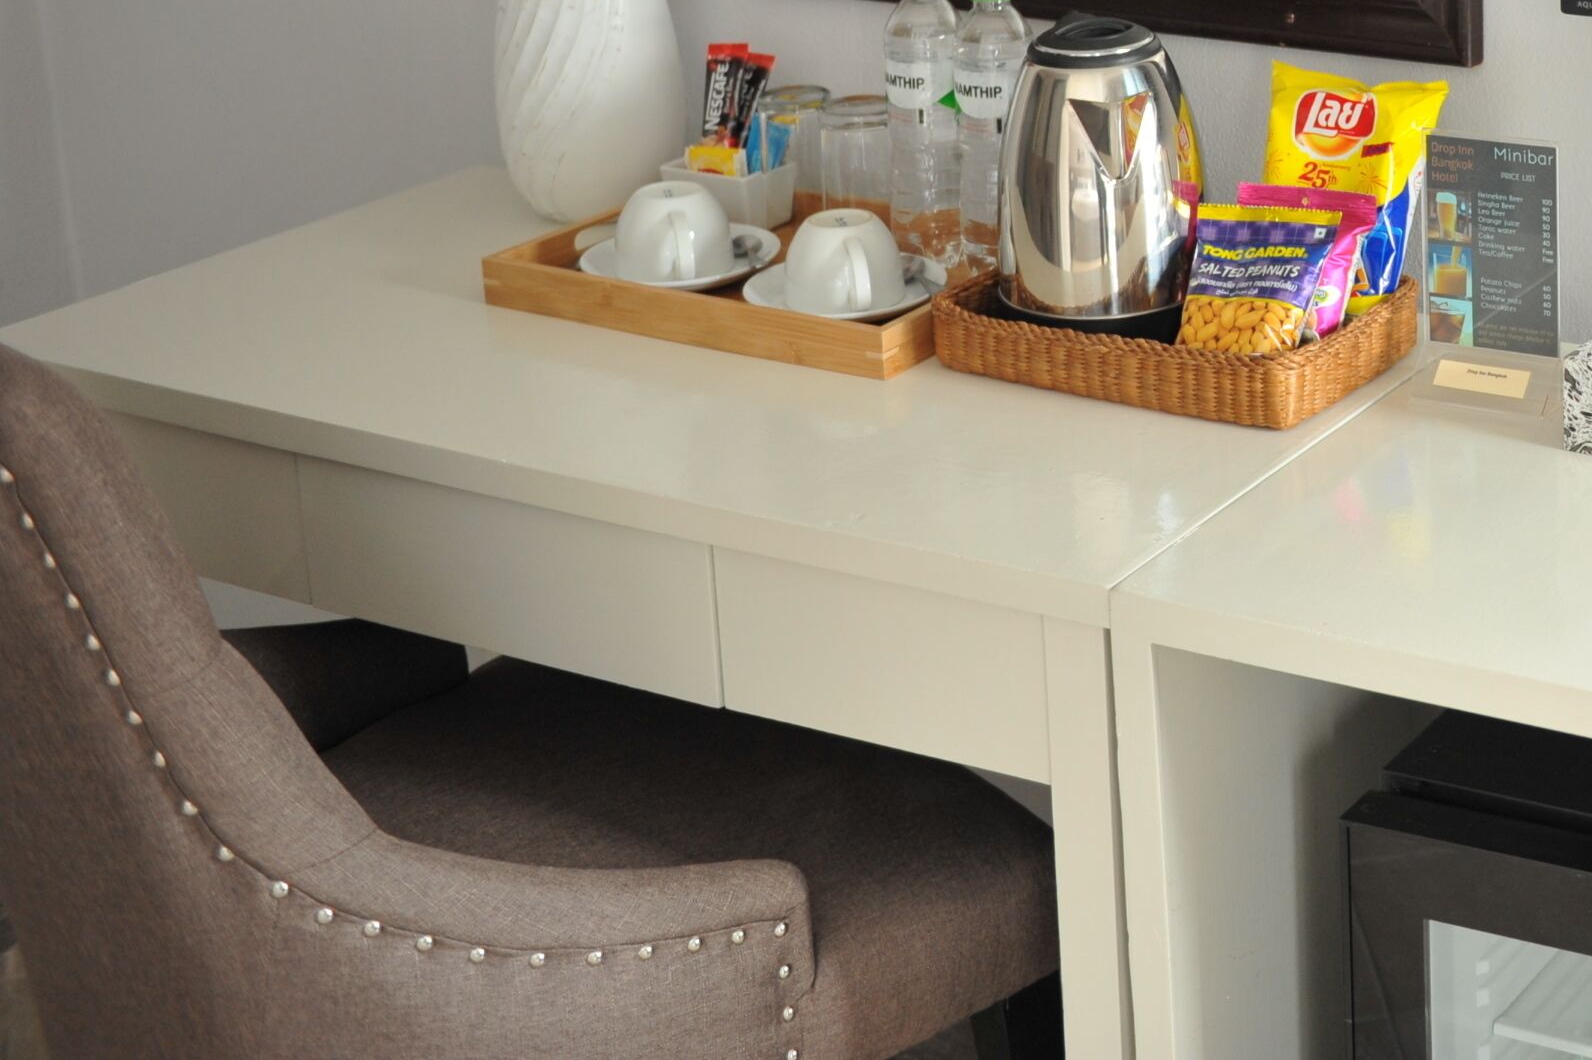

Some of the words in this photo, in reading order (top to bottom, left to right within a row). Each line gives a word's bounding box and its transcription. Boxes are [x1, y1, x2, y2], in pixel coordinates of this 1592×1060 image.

[886, 72, 925, 90] AMTHIP
[1431, 156, 1474, 171] Bangkok
[1494, 146, 1554, 166] Minibar
[1431, 171, 1458, 182] Hotel
[1500, 171, 1520, 181] PRICE
[1522, 174, 1536, 182] LIST
[1478, 232, 1494, 240] Coke
[1203, 243, 1243, 261] TONG
[1244, 245, 1305, 259] GARDEN
[1198, 262, 1246, 278] SALTED
[1245, 264, 1301, 278] PEANUTS
